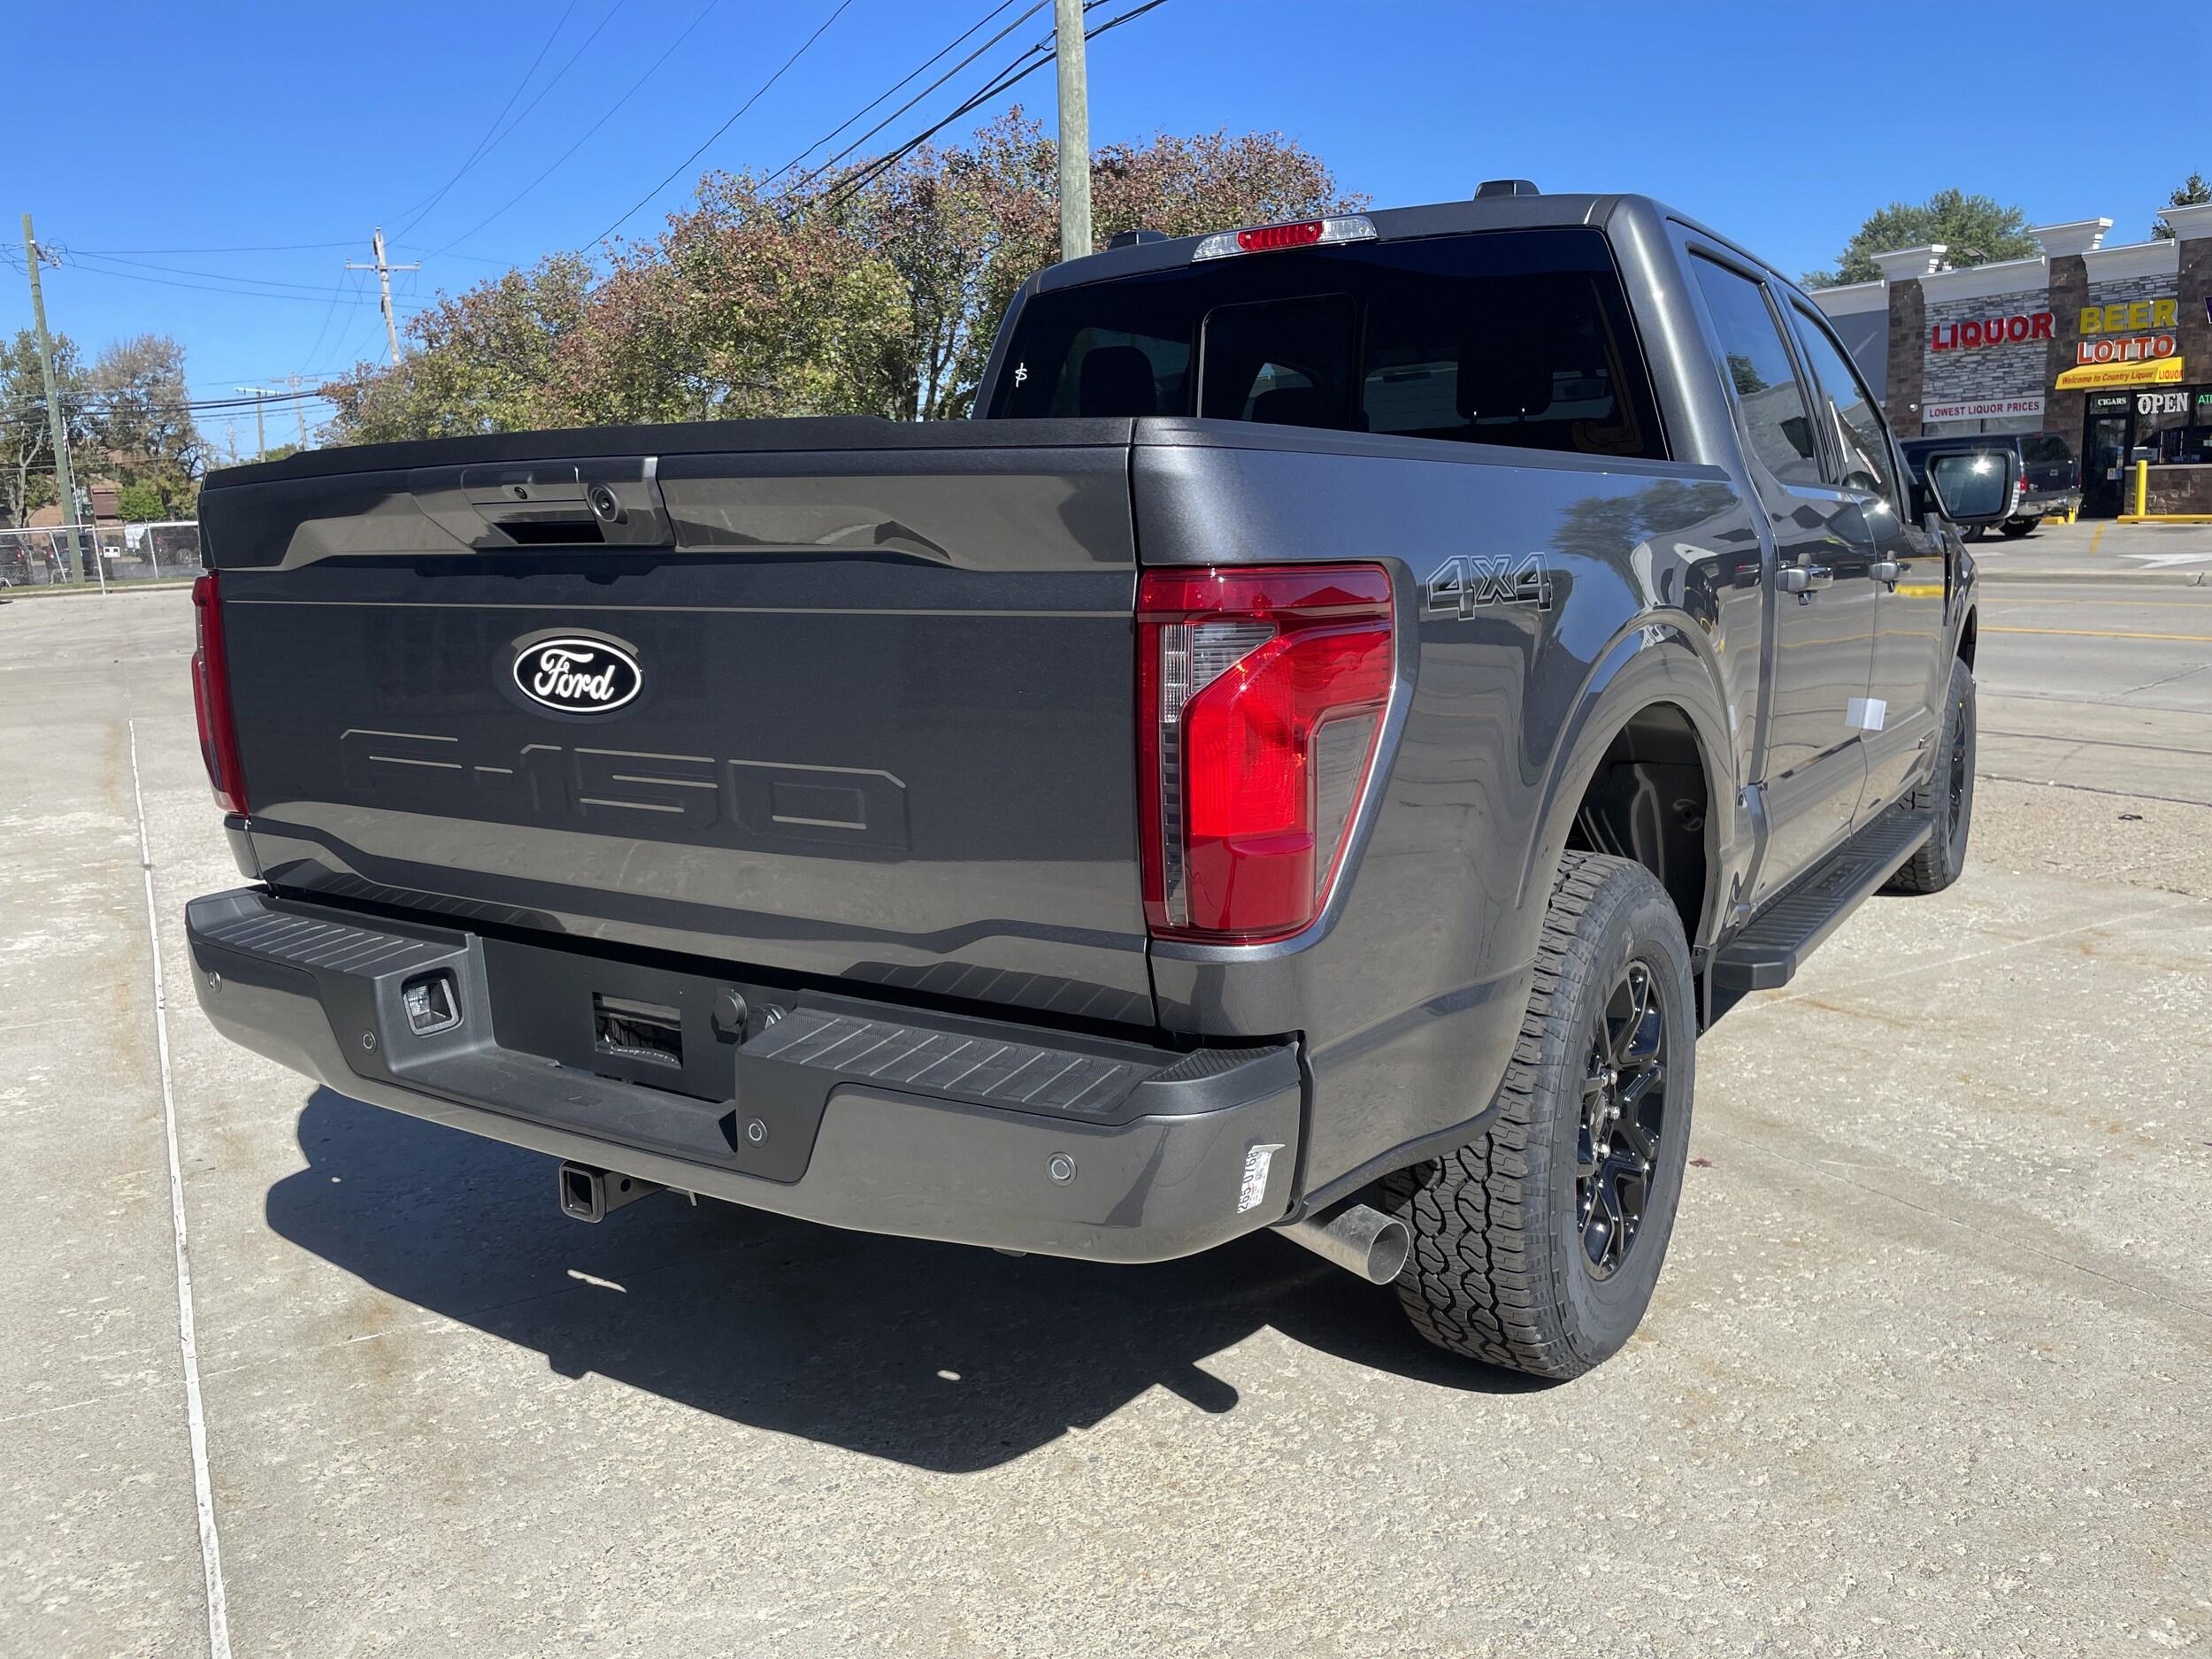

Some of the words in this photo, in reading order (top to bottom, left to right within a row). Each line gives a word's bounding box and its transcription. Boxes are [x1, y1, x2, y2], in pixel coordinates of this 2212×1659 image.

[2079, 298, 2178, 334] BEER
[1932, 312, 2055, 351] LIQUOR
[2077, 334, 2177, 365] LOTTO
[2062, 376, 2093, 385] Welcome
[2102, 373, 2130, 382] Country
[2131, 371, 2154, 380] Liquor
[2158, 369, 2184, 380] LIQUOR
[1929, 406, 1965, 418] LOWEST
[1968, 403, 2003, 415] LIQUOR
[2007, 401, 2039, 412] PRICES
[2097, 397, 2127, 406] CIGARS
[2136, 392, 2189, 415] OPEN
[2198, 395, 2212, 404] AT
[534, 649, 616, 701] Ford
